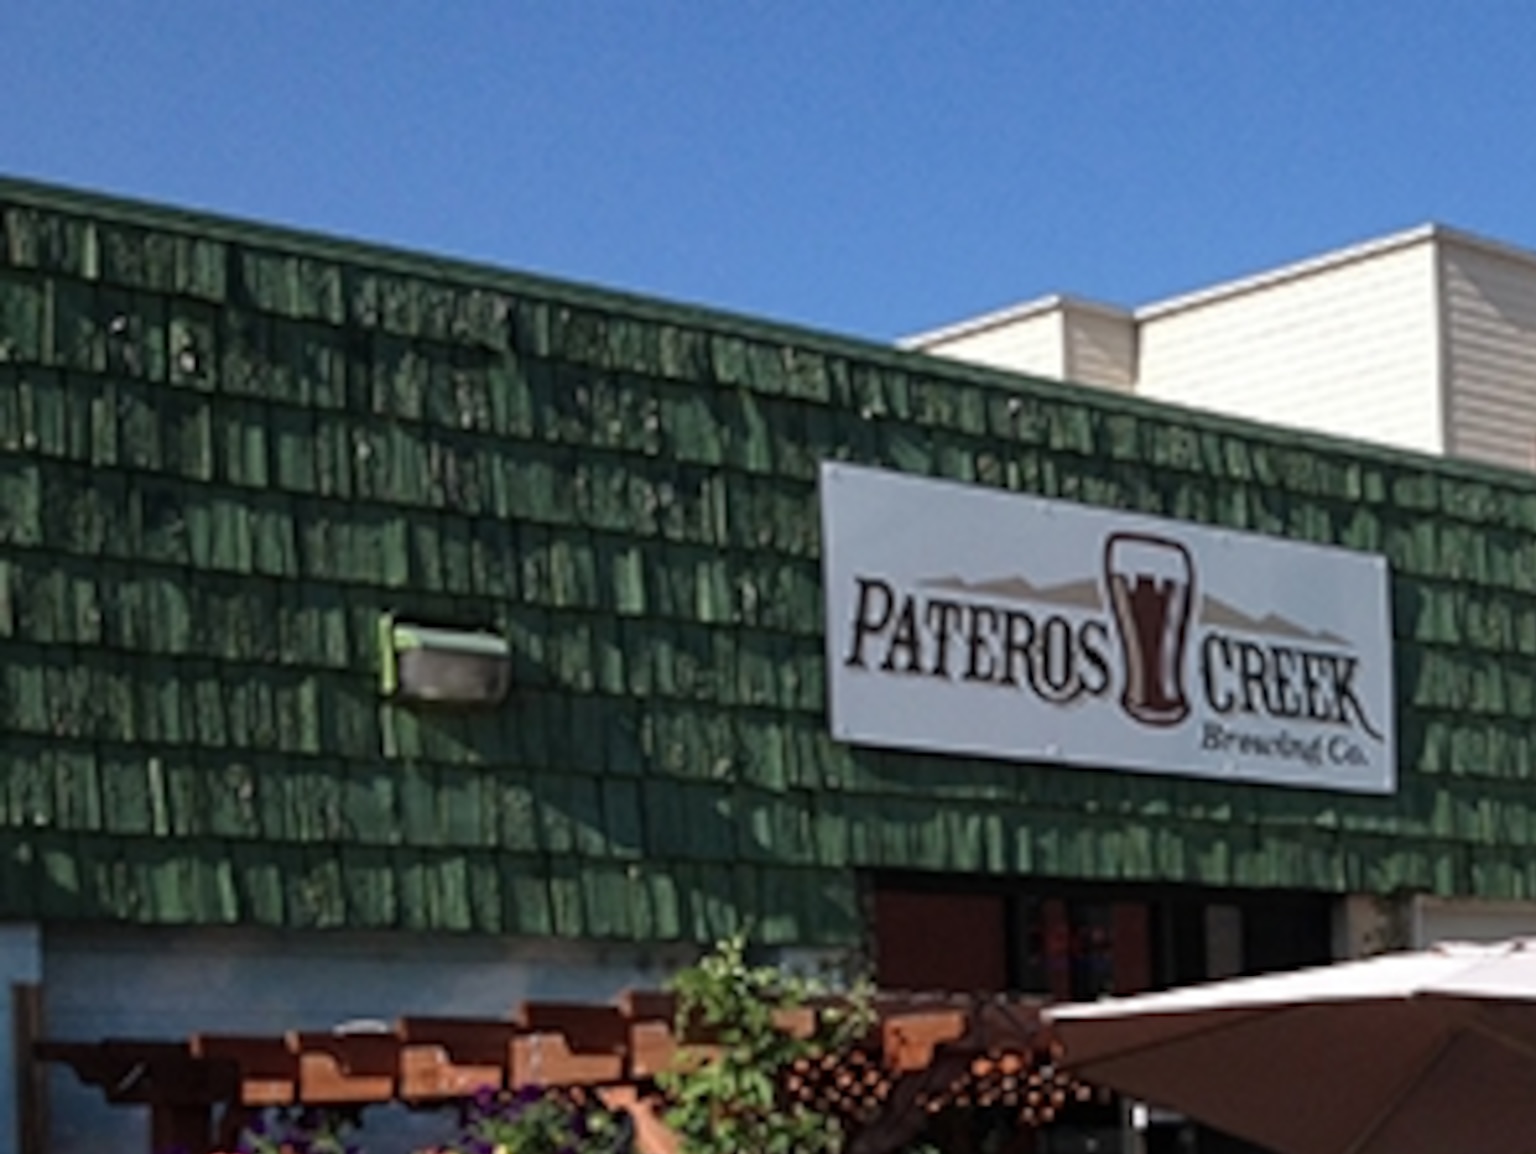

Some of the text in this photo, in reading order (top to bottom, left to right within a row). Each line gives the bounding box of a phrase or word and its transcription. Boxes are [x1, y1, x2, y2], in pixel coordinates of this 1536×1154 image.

[844, 577, 1385, 742] PATEROS CREEK
[1203, 721, 1370, 767] Brewing Co.
